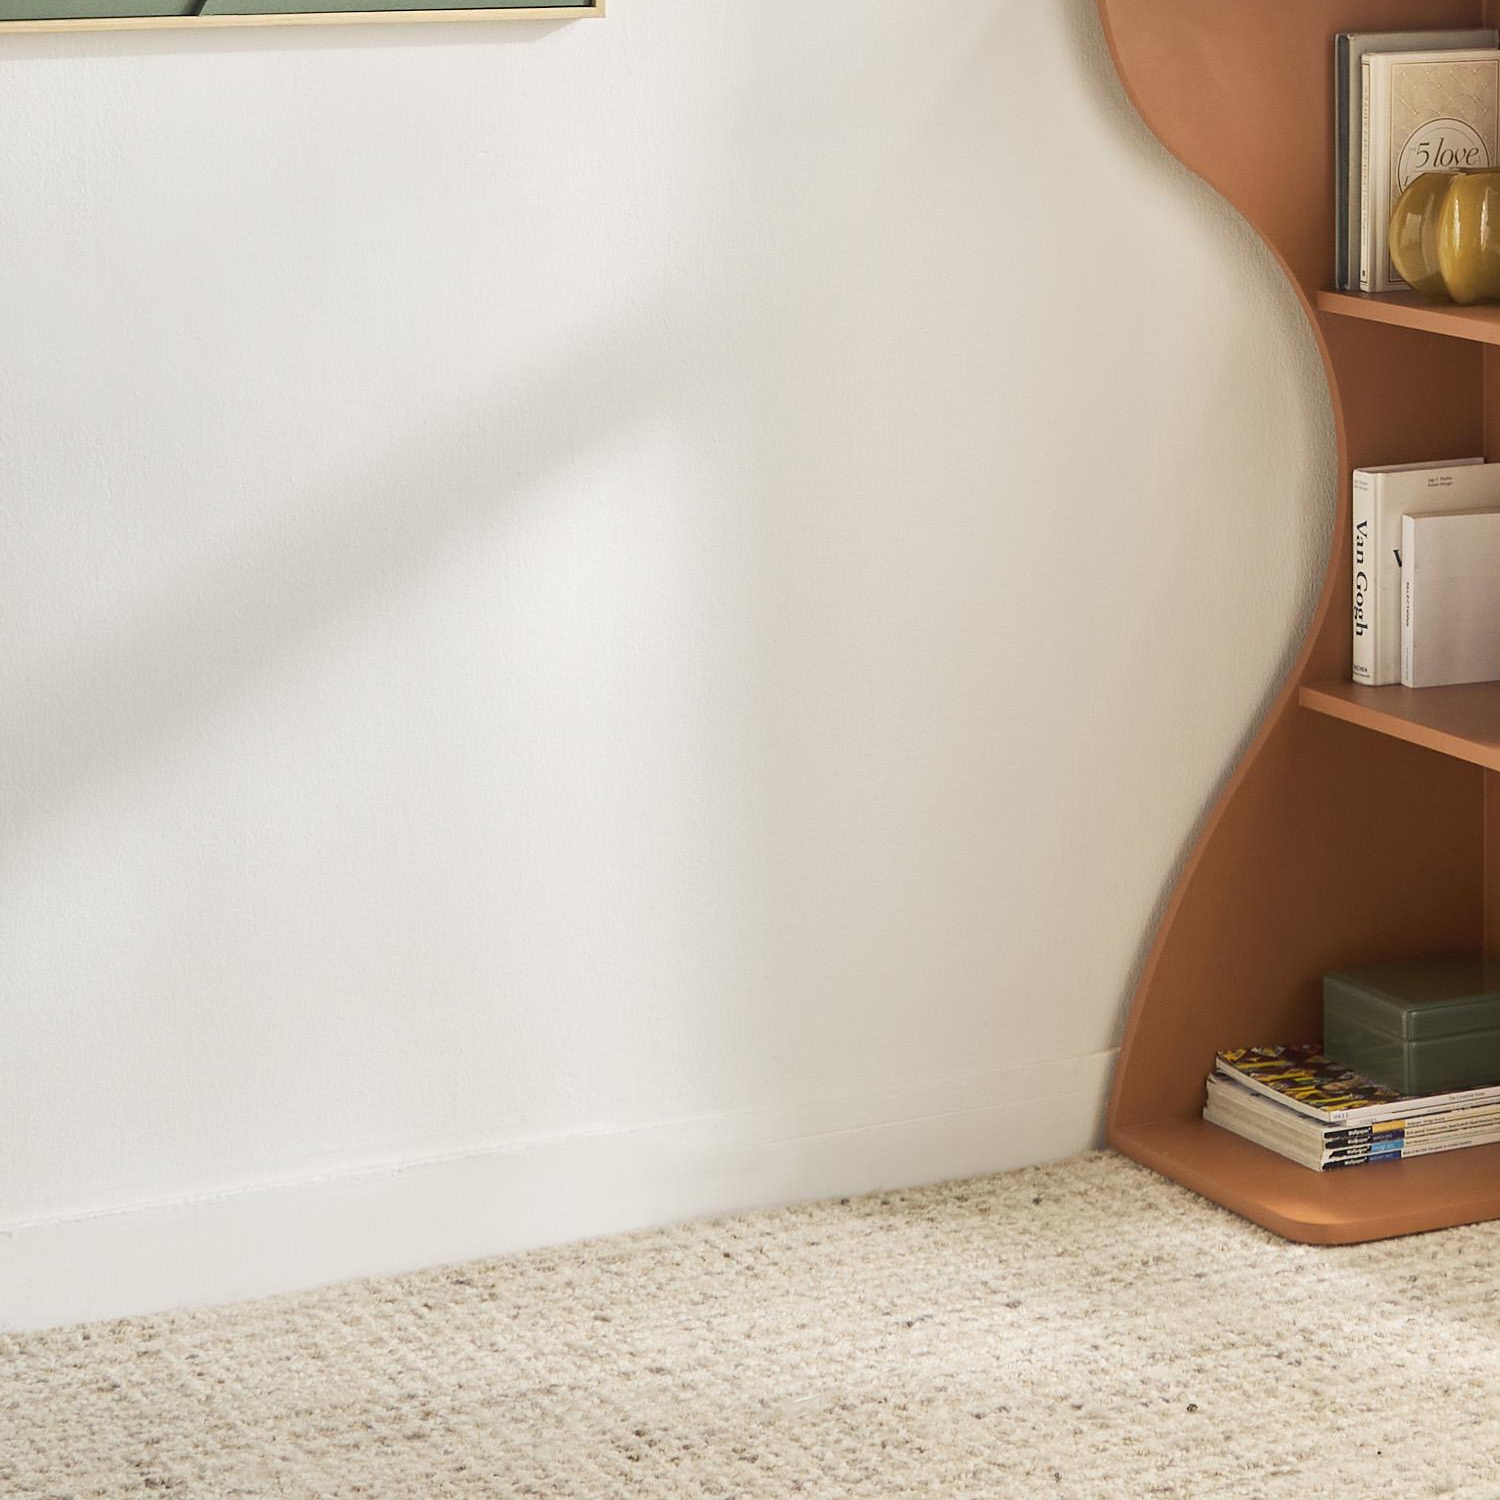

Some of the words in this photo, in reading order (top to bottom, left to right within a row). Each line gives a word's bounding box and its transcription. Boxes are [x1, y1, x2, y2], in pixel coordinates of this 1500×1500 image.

[1415, 142, 1431, 169] 5
[1433, 137, 1480, 168] love
[1356, 520, 1368, 565] Van
[1353, 571, 1369, 637] Gogh
